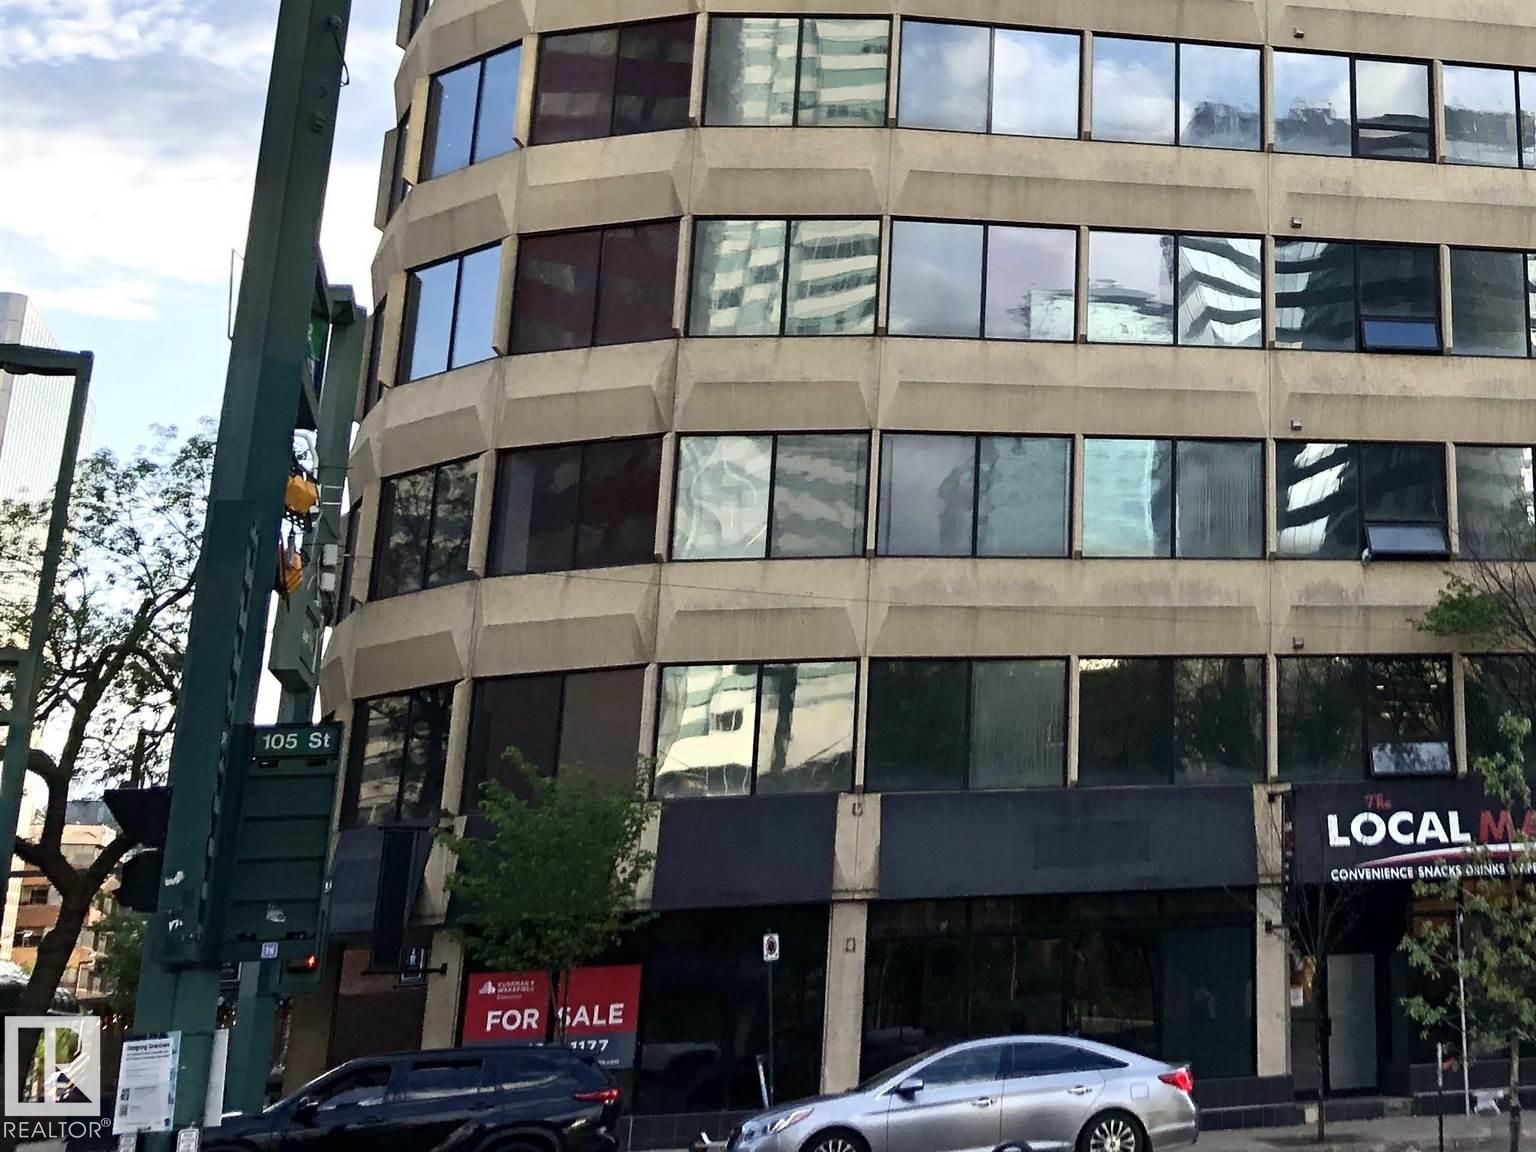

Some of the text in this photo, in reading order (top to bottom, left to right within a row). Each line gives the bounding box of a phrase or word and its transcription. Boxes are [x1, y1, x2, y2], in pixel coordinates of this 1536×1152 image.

[262, 732, 331, 750] 105 St
[1327, 810, 1471, 847] LOCAL
[1330, 864, 1414, 882] CONVENIENCE
[1418, 864, 1462, 879] SNACKS
[485, 1002, 625, 1032] FOR SALE
